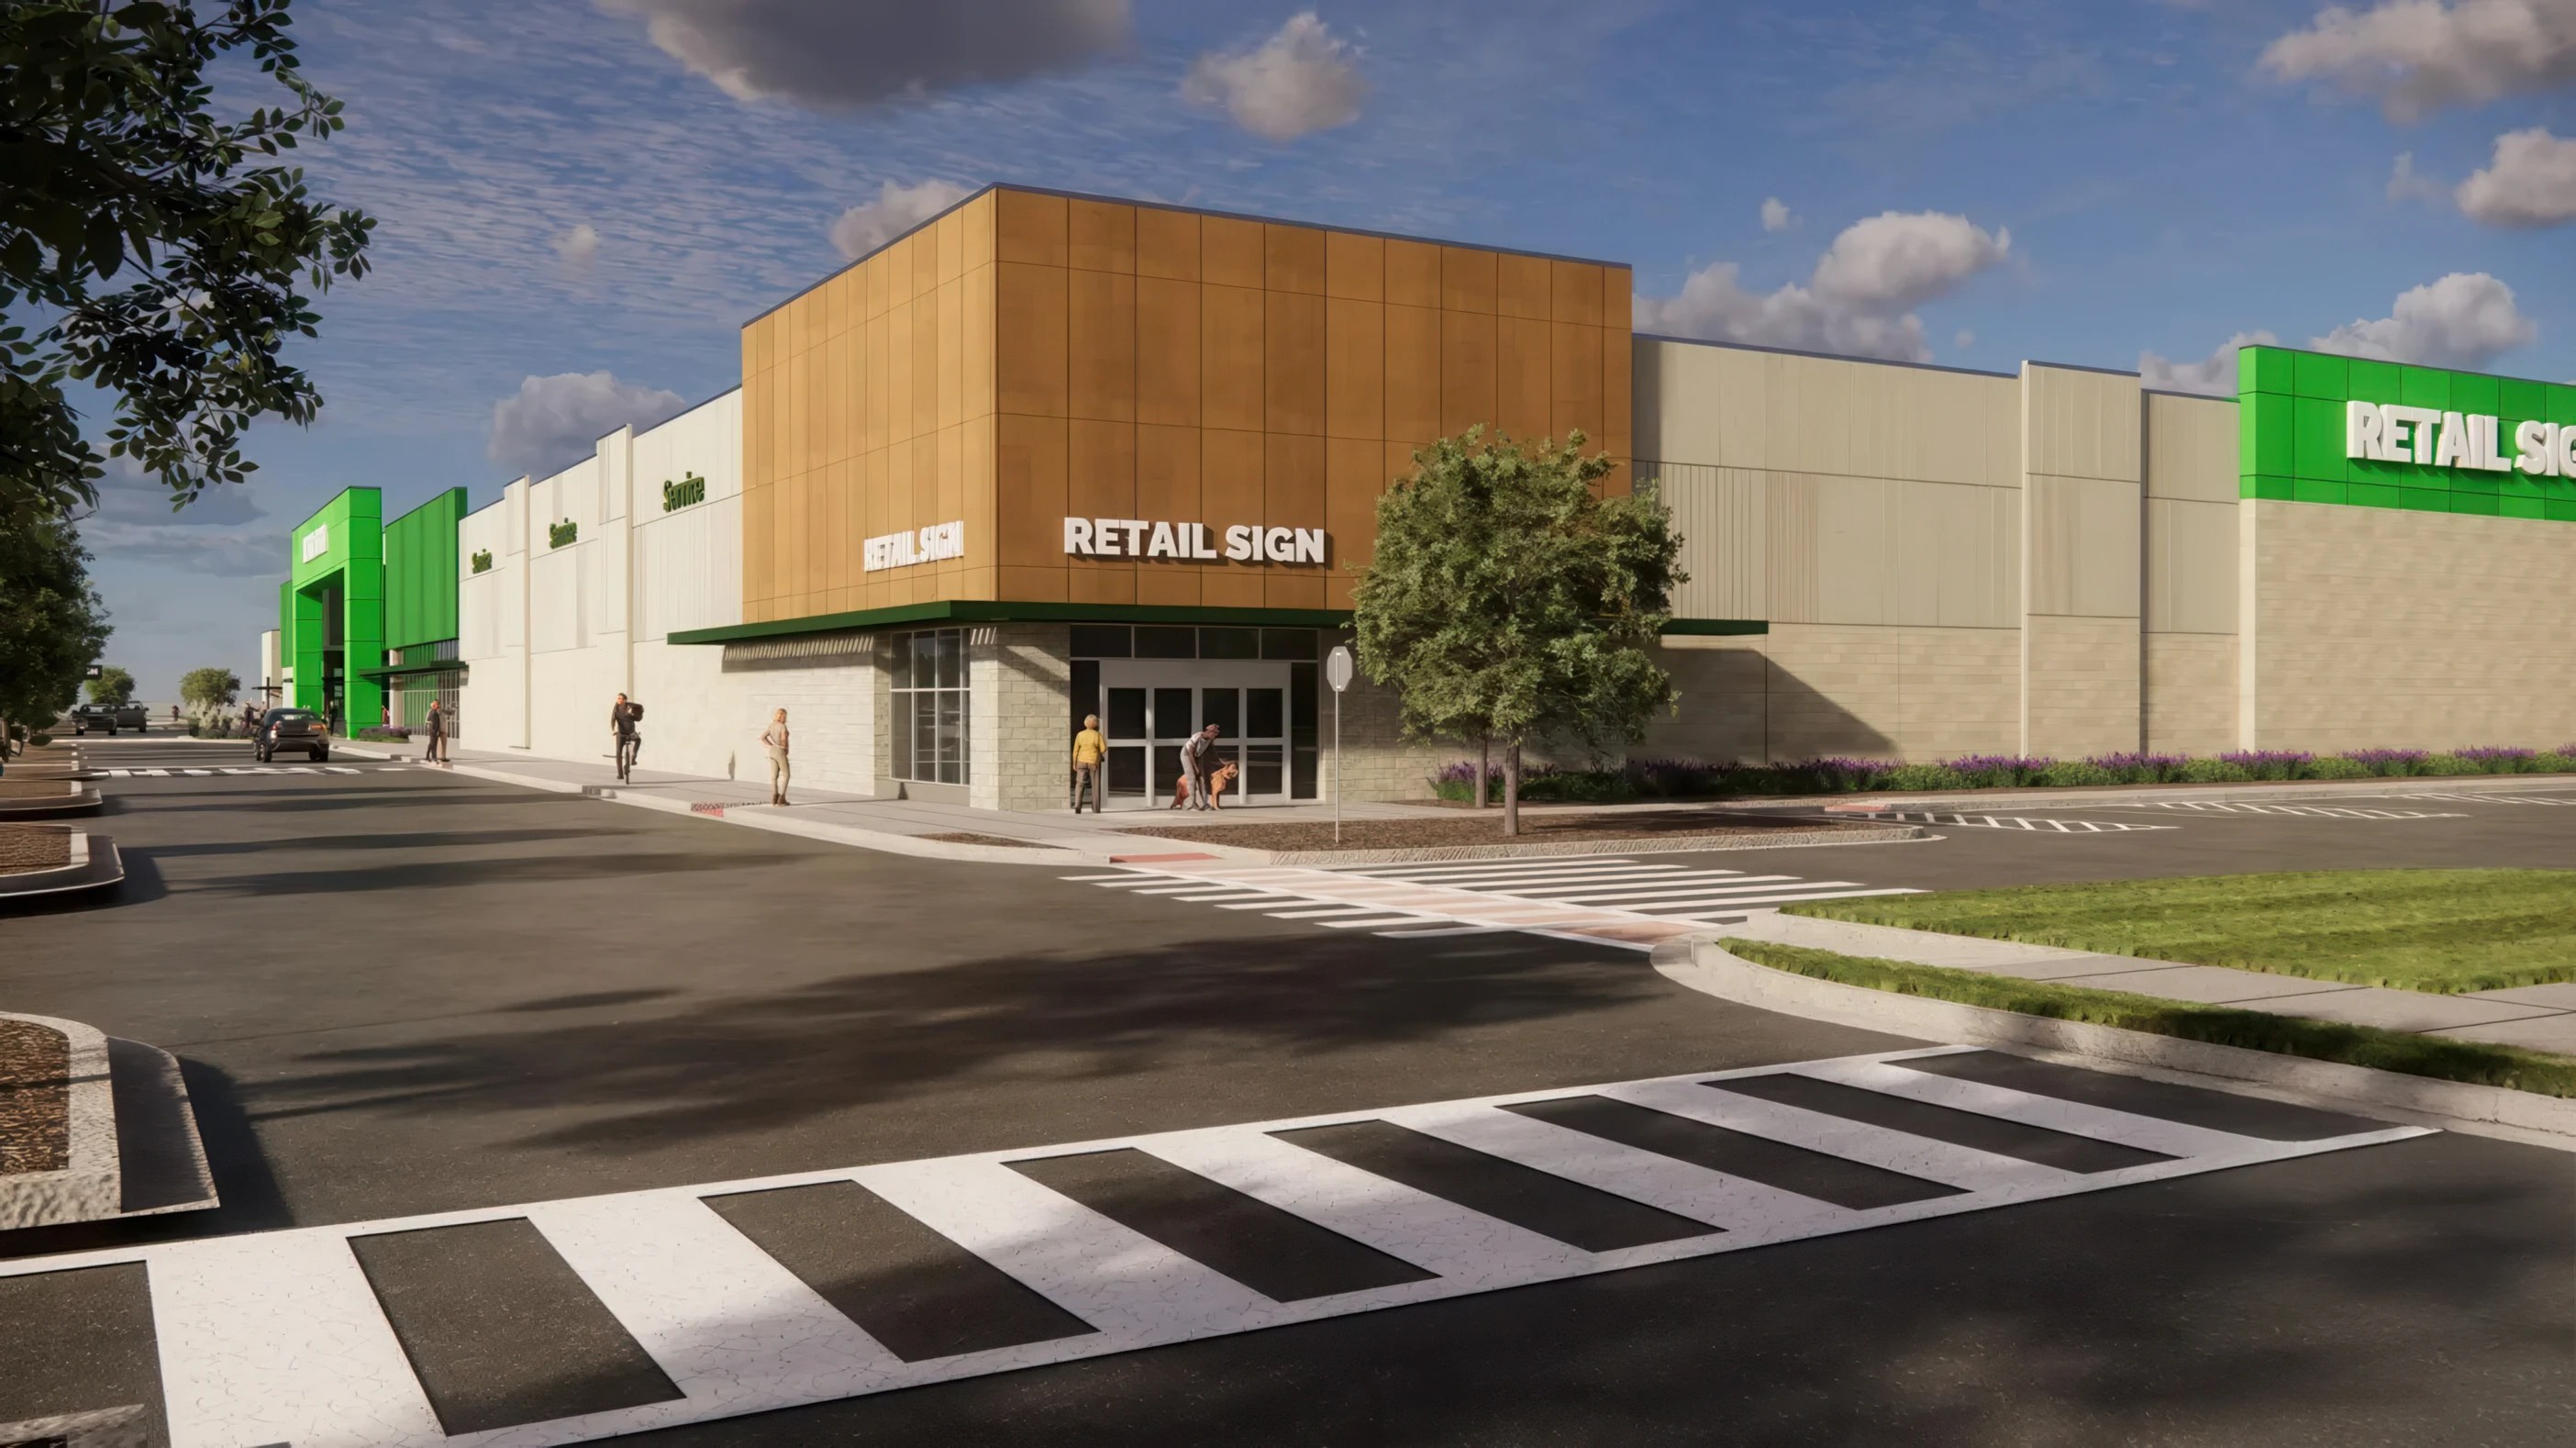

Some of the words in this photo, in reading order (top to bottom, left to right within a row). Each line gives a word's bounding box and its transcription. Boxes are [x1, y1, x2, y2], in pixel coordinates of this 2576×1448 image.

[2347, 400, 2512, 472] RETAIL
[864, 530, 920, 573] RETAIL
[919, 520, 964, 562] SIGN
[1064, 517, 1217, 559] RETAIL
[1225, 524, 1325, 563] SIGN
